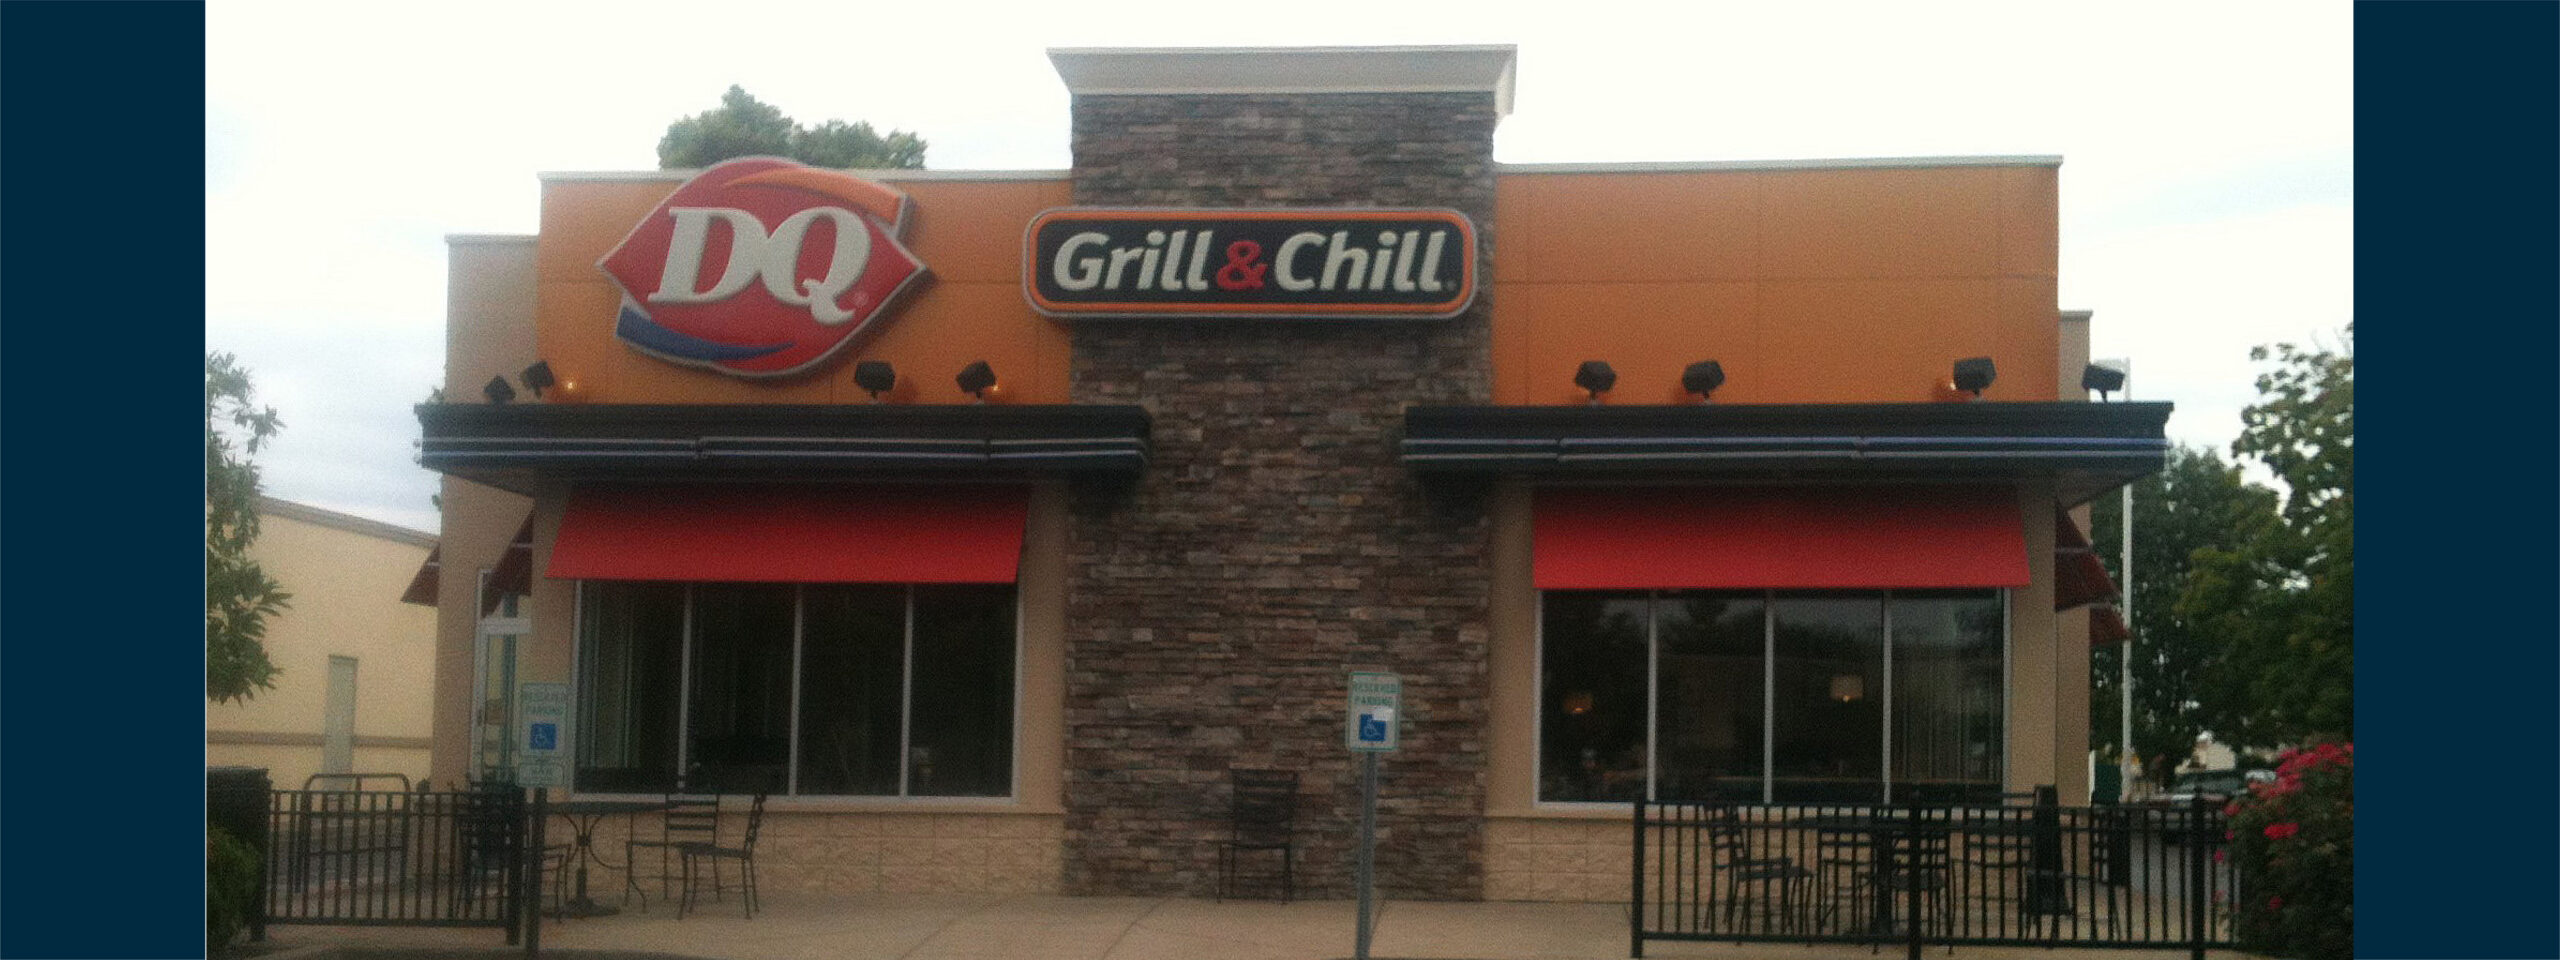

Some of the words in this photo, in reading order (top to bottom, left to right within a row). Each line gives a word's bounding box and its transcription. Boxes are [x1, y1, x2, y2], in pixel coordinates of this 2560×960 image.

[648, 206, 872, 326] DQ
[1053, 230, 1213, 291] Grill
[1274, 230, 1447, 292] Chill
